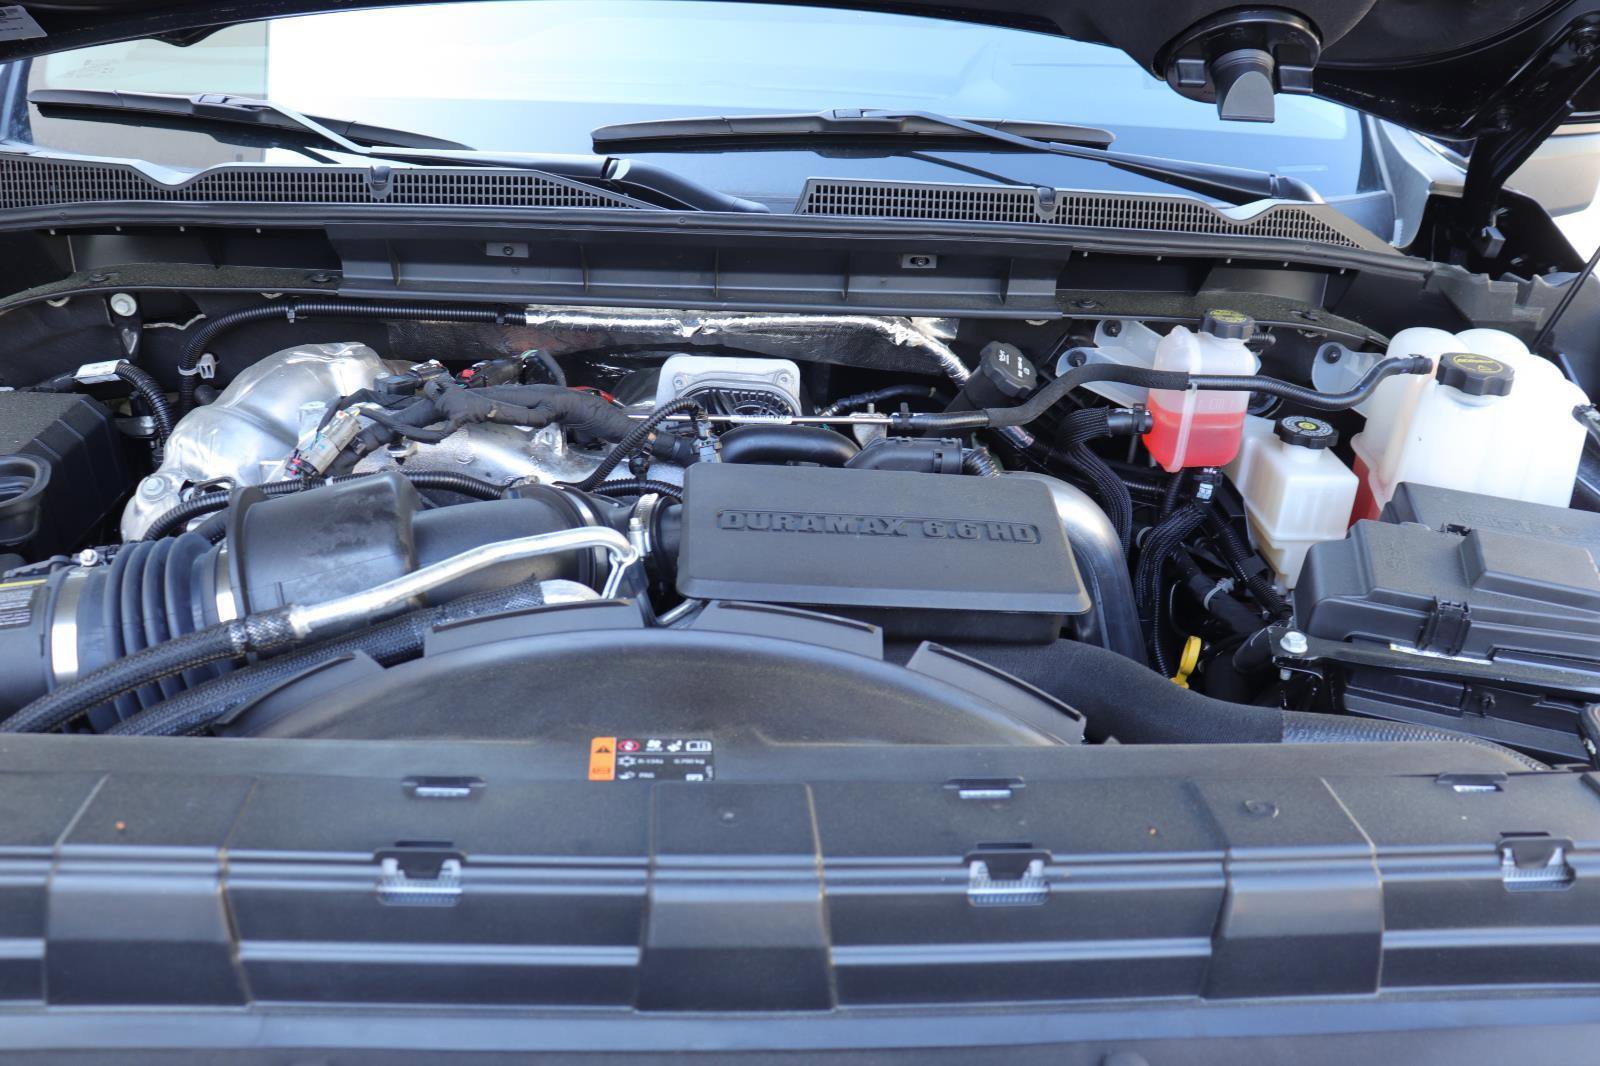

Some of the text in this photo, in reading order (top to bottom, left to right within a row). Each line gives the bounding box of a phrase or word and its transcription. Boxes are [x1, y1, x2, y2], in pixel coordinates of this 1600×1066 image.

[720, 510, 1041, 544] DURAMAX 6.6 HD
